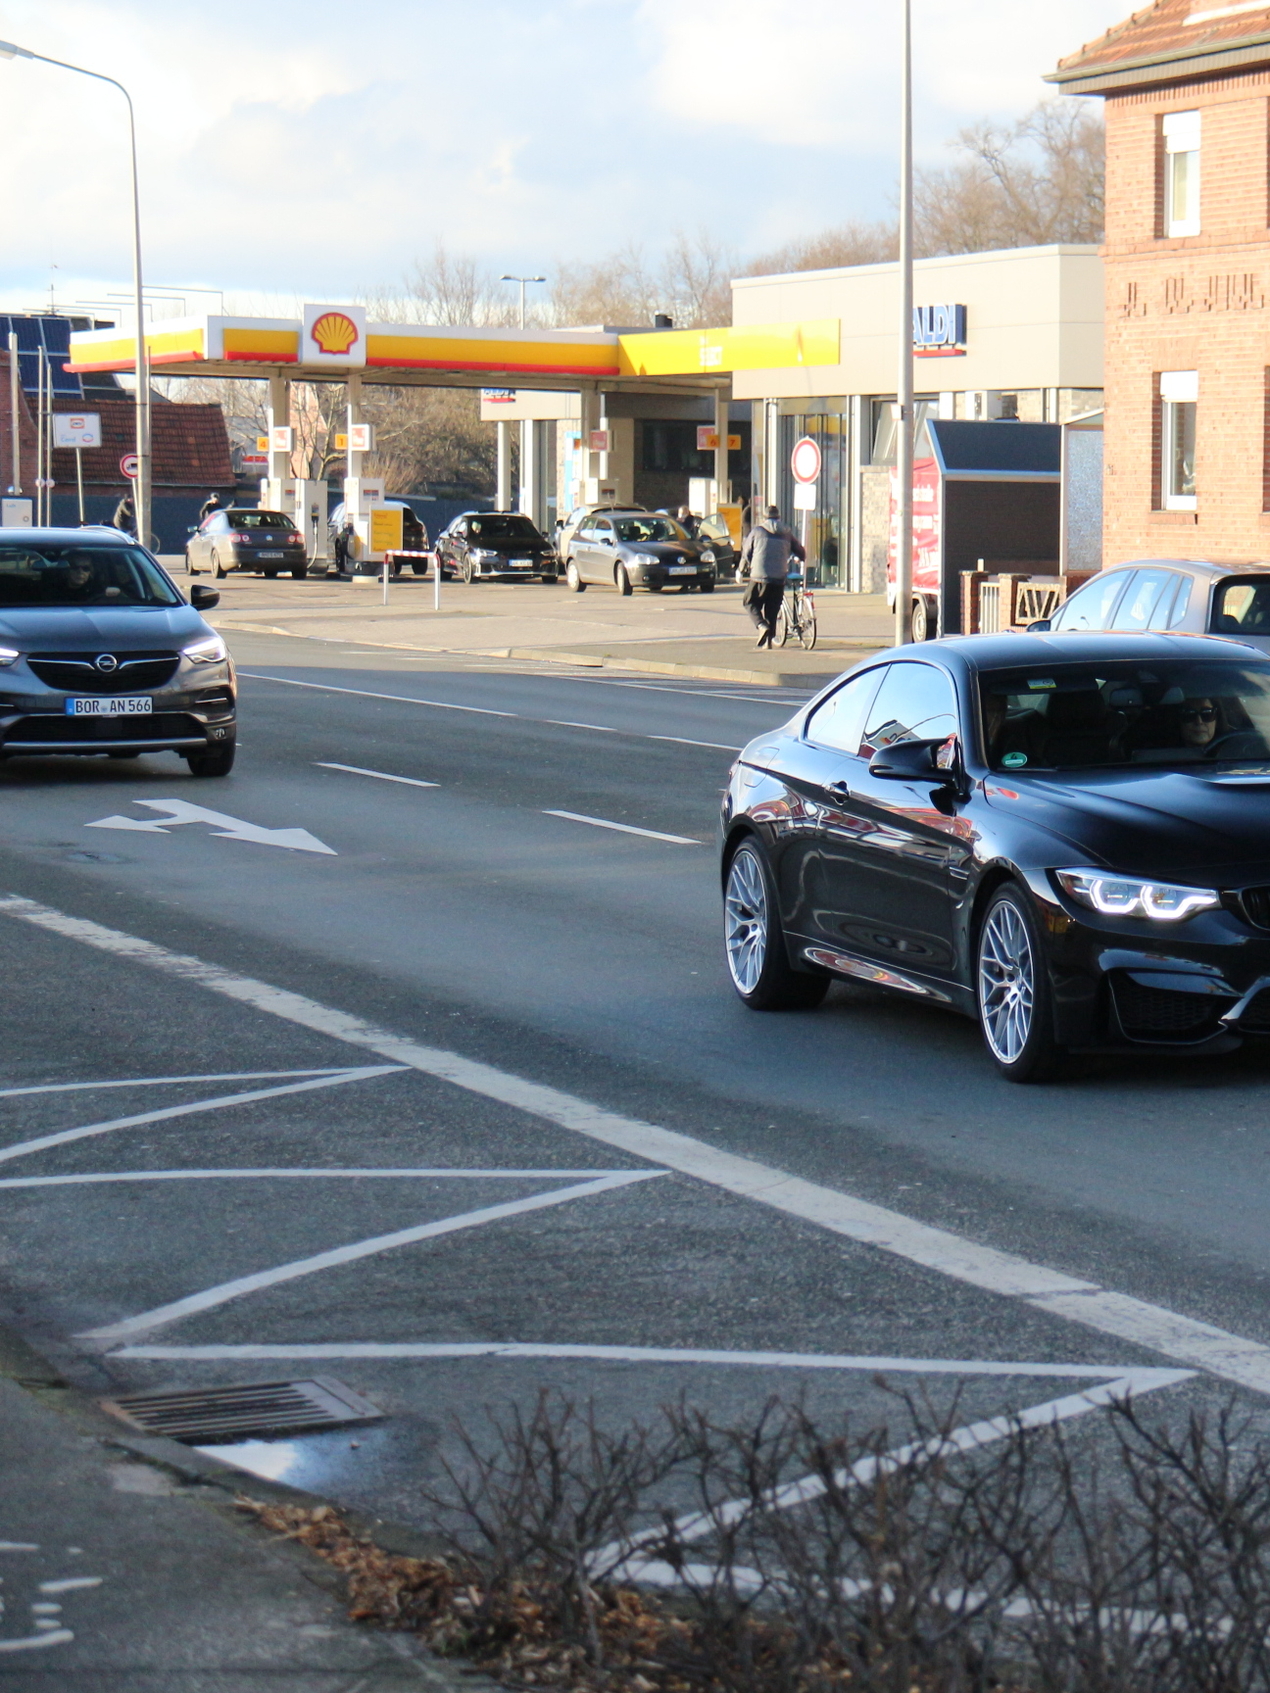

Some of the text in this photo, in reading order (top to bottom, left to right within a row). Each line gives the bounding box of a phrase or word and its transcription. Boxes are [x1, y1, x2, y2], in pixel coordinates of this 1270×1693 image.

[913, 303, 957, 347] ALDI
[75, 700, 100, 713] BOR
[109, 699, 126, 713] AN
[128, 699, 151, 712] 566
